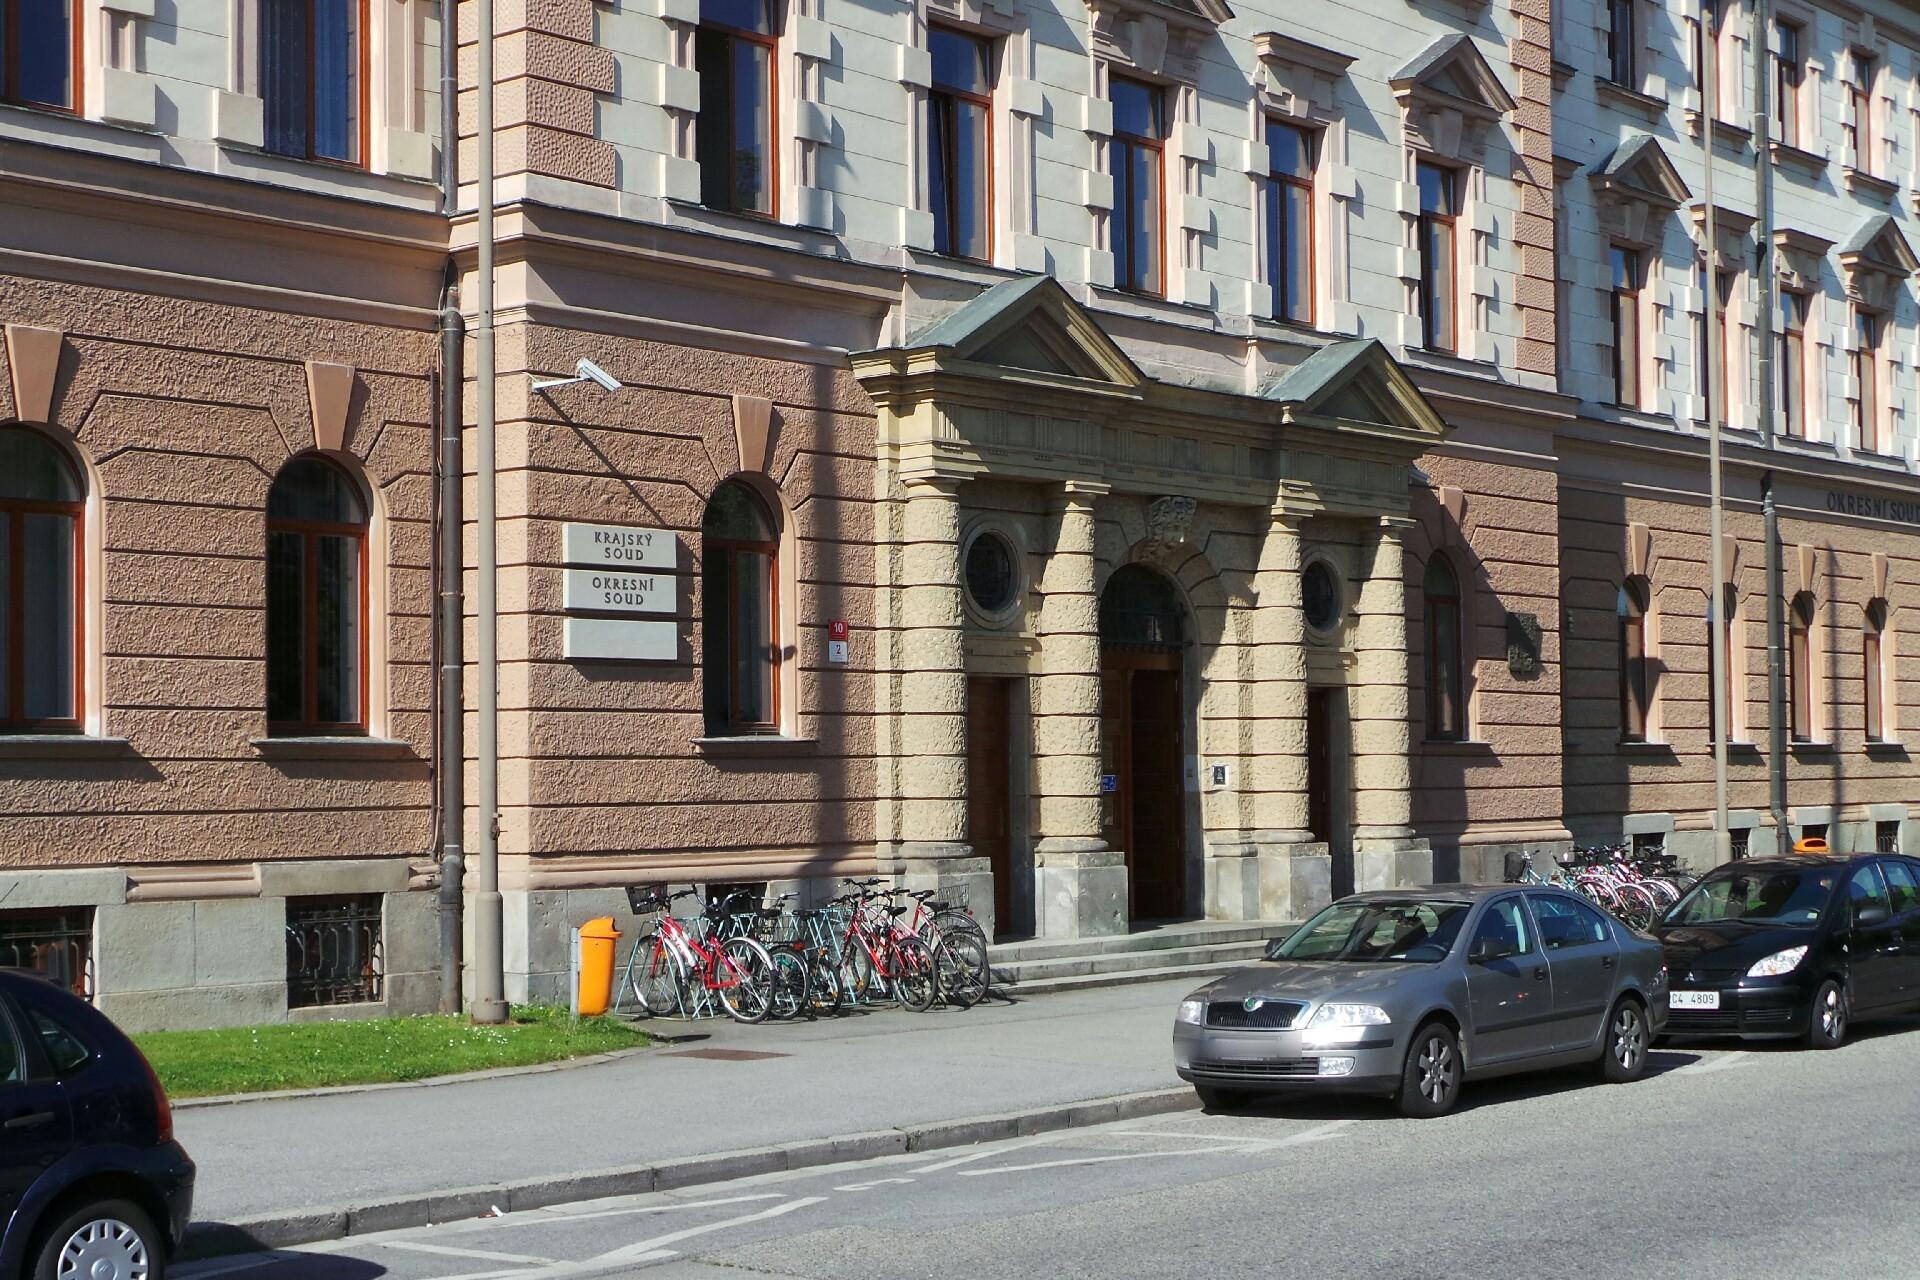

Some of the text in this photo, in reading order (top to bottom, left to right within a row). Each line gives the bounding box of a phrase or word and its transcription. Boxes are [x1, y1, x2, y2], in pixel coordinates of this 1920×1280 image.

[594, 531, 653, 547] KRAJSKÝ
[604, 547, 644, 560] SOUD
[592, 577, 654, 591] OKRESNÍ
[604, 592, 644, 605] SOUD
[833, 622, 843, 633] 10
[835, 644, 841, 655] 2
[1691, 993, 1714, 1004] 4809
